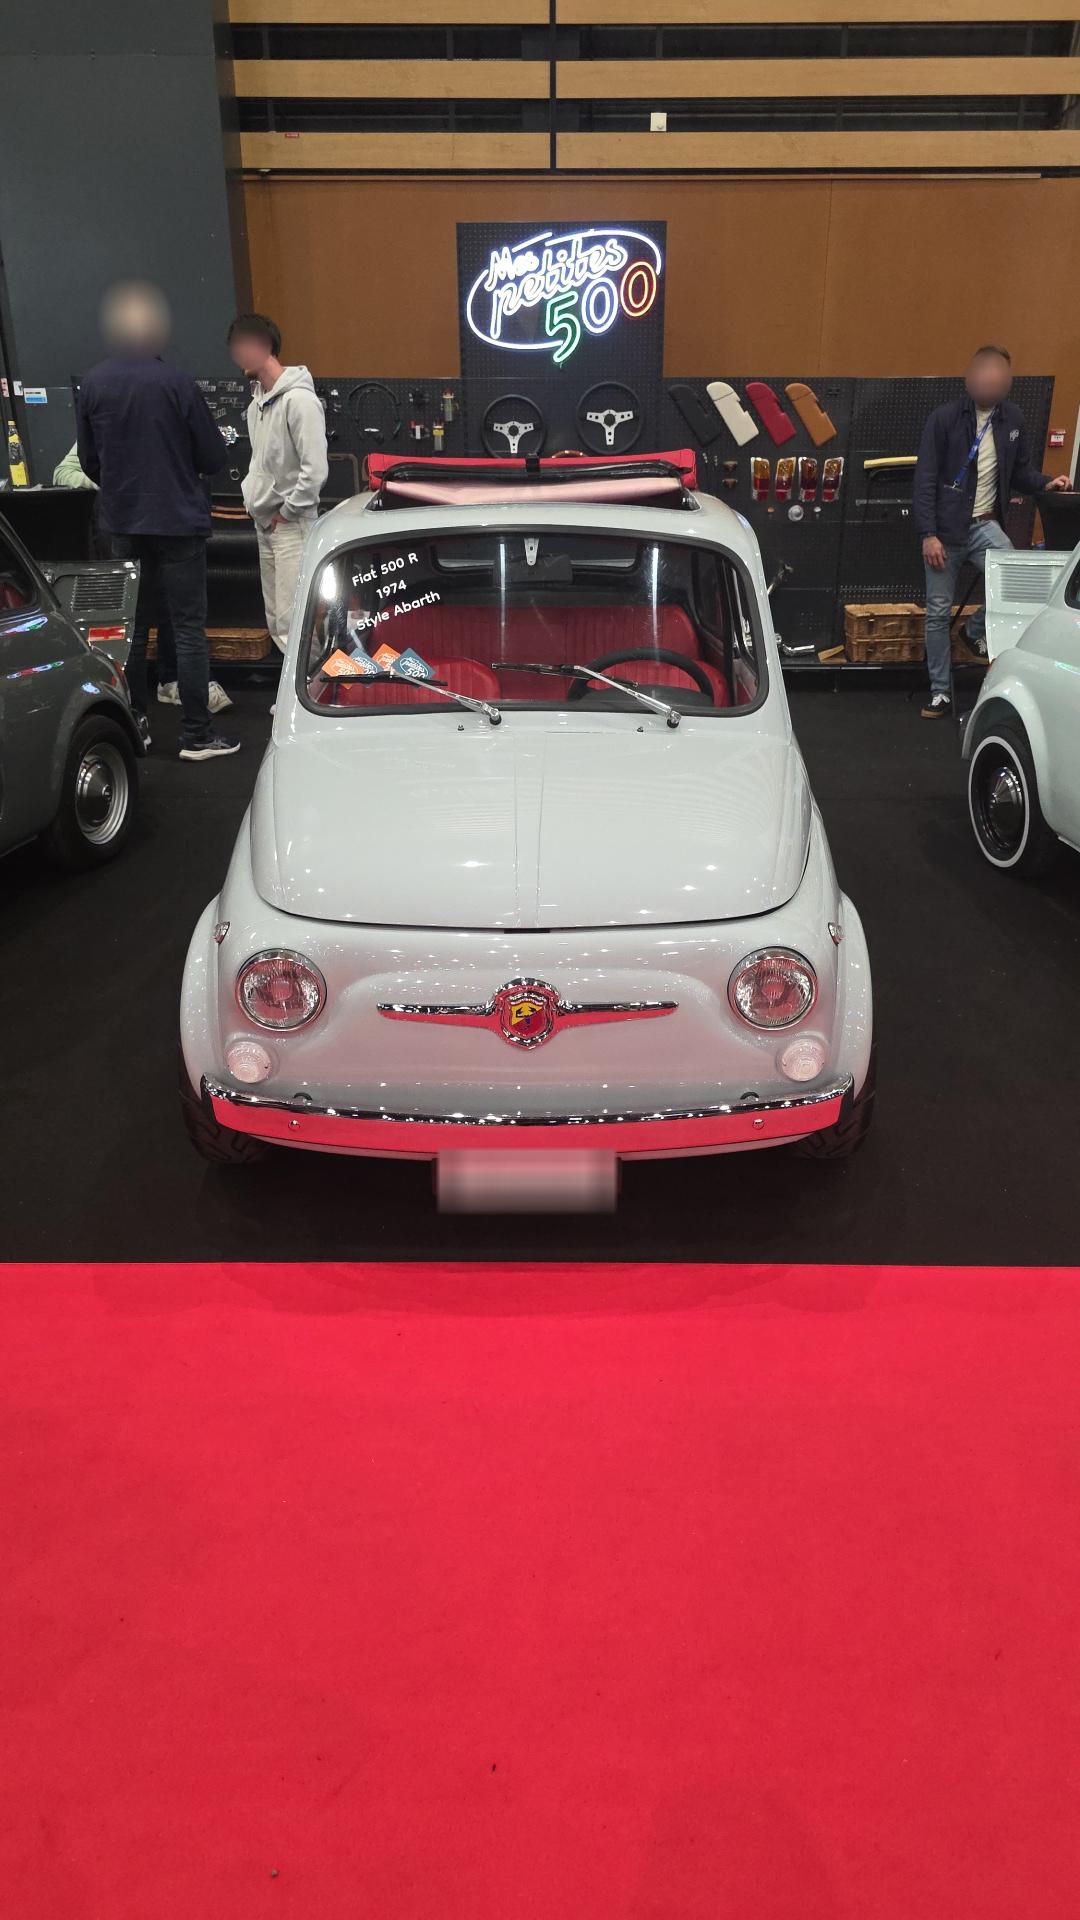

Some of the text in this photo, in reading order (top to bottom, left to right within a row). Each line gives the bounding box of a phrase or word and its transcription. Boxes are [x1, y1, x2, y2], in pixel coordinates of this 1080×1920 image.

[484, 247, 539, 291] Mes
[491, 237, 628, 339] petites
[545, 261, 657, 362] 500
[352, 552, 418, 586] Fiat 500 R
[376, 579, 407, 599] 1974
[356, 591, 441, 631] Style Abarth
